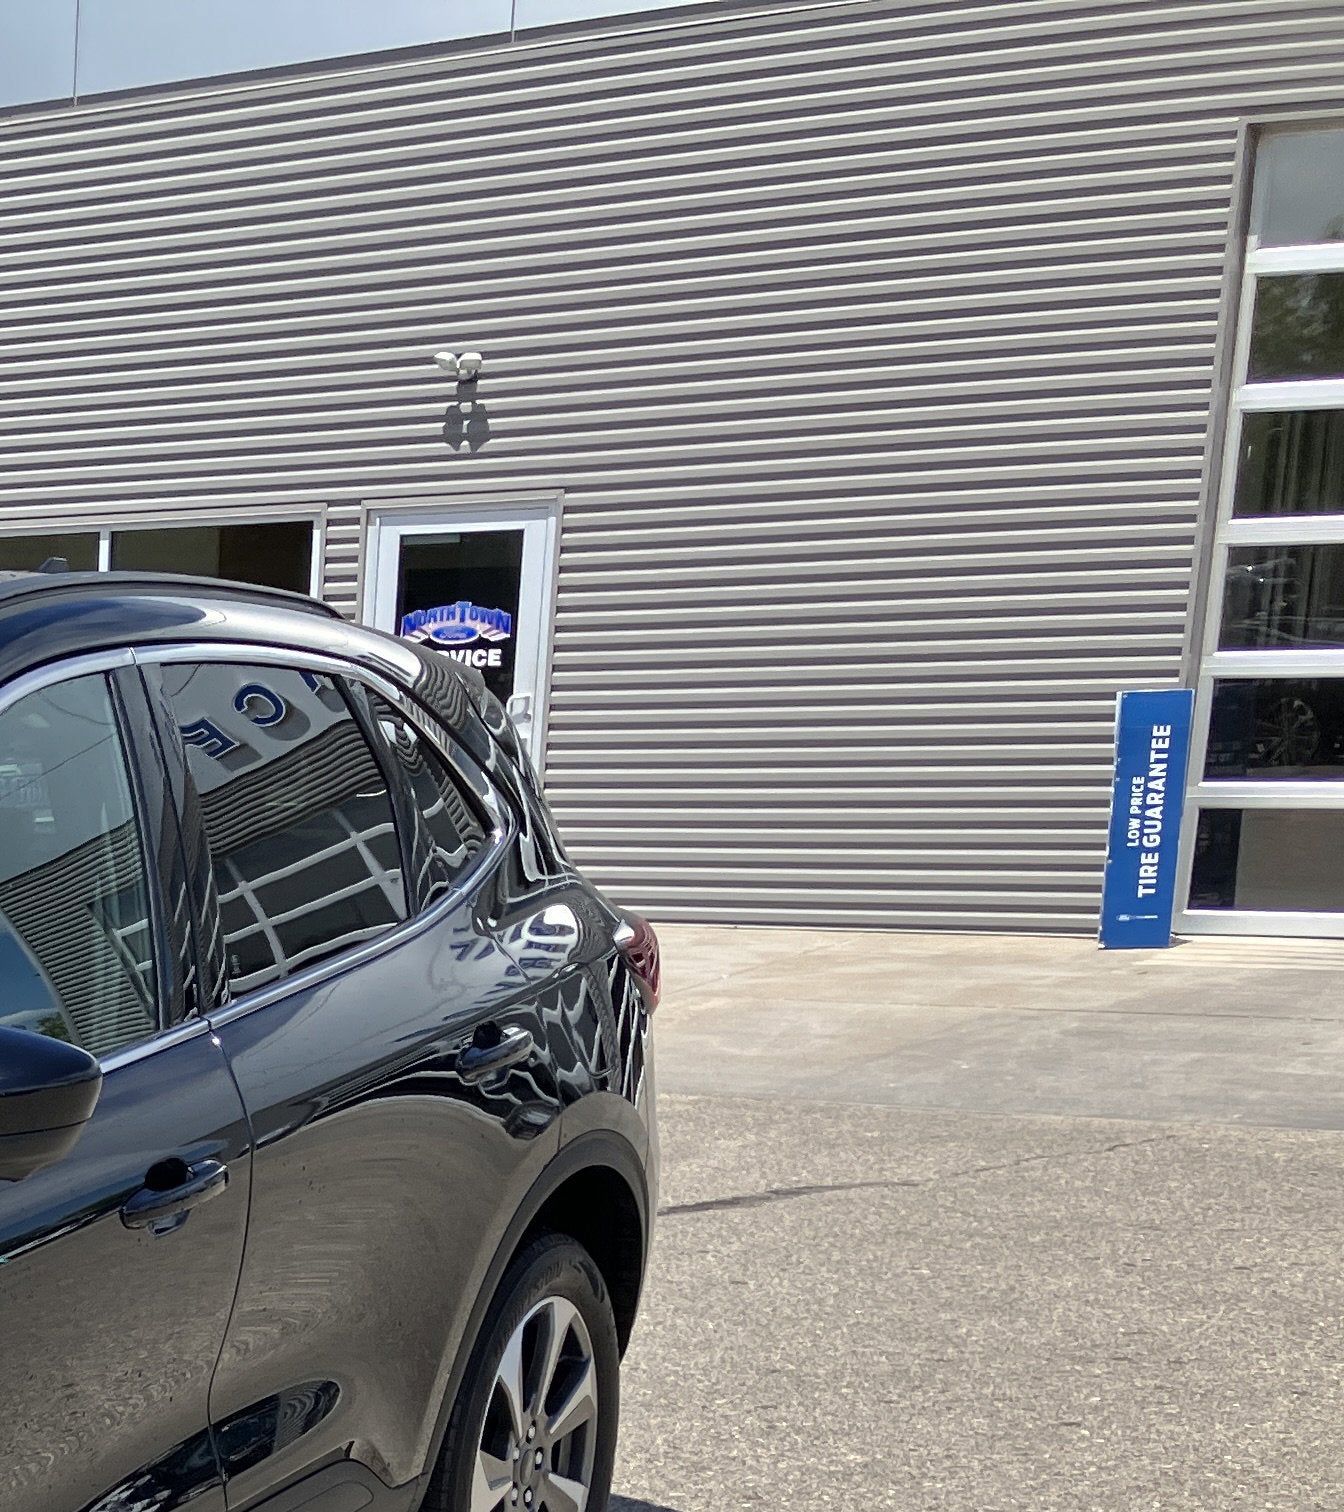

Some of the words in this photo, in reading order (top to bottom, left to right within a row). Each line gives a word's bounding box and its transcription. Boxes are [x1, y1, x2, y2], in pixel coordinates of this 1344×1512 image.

[1129, 775, 1145, 815] PRICE
[1141, 723, 1172, 849] GUARANTEE
[1126, 817, 1140, 847] LOW
[1137, 851, 1159, 899] TIRE
